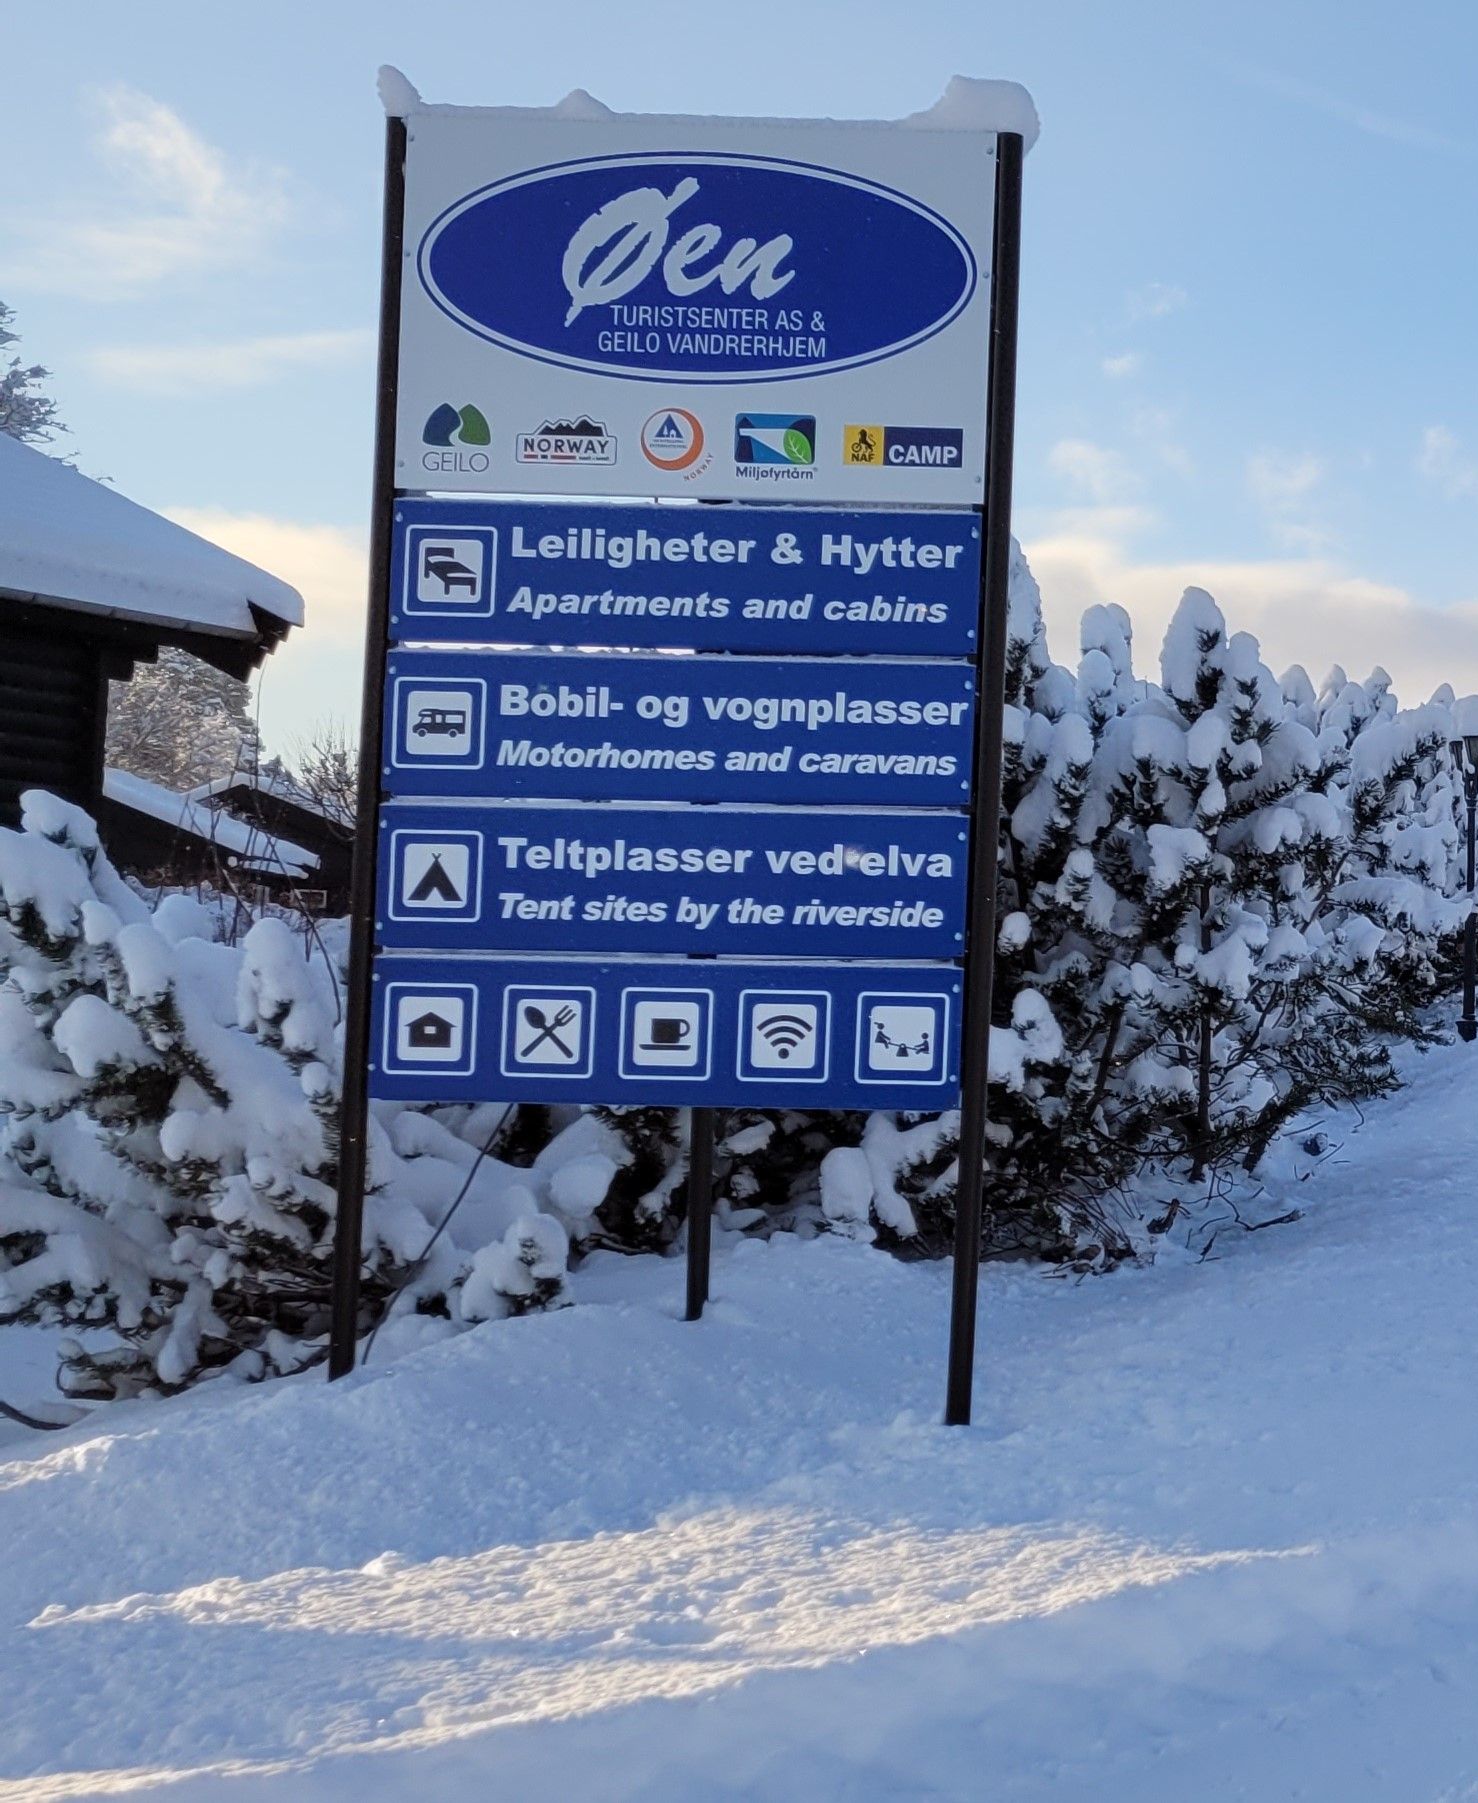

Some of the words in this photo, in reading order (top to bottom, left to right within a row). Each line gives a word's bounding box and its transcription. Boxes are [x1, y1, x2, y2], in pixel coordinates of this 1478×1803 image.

[562, 177, 795, 327] Øen
[610, 305, 768, 330] TURISTSENTER
[775, 310, 803, 331] AS
[810, 312, 825, 331] &
[598, 331, 660, 353] GEILO
[667, 333, 826, 357] VANDRERHJEM
[422, 451, 489, 472] GEILO
[523, 438, 609, 454] NORWAY
[851, 453, 875, 462] NAF
[888, 444, 958, 464] CAMP
[736, 466, 813, 482] Miljøfyrtårn
[511, 527, 756, 568] Leiligheter
[771, 533, 804, 564] &
[821, 534, 963, 574] Hytter
[507, 586, 729, 620] Apartments
[742, 593, 811, 621] and
[823, 595, 948, 624] cabins
[500, 684, 623, 718] Bobil-
[636, 696, 689, 728] og
[702, 692, 968, 730] vognplasser
[497, 740, 715, 771] Motorhomes
[724, 746, 791, 773] and
[799, 751, 956, 776] caravans
[498, 837, 752, 877] Teltplasser
[765, 844, 843, 875] ved
[860, 846, 953, 878] elva
[498, 893, 574, 921] Tent
[581, 895, 667, 924] sites
[676, 896, 720, 930] by
[727, 898, 785, 925] the
[792, 899, 944, 928] riverside
